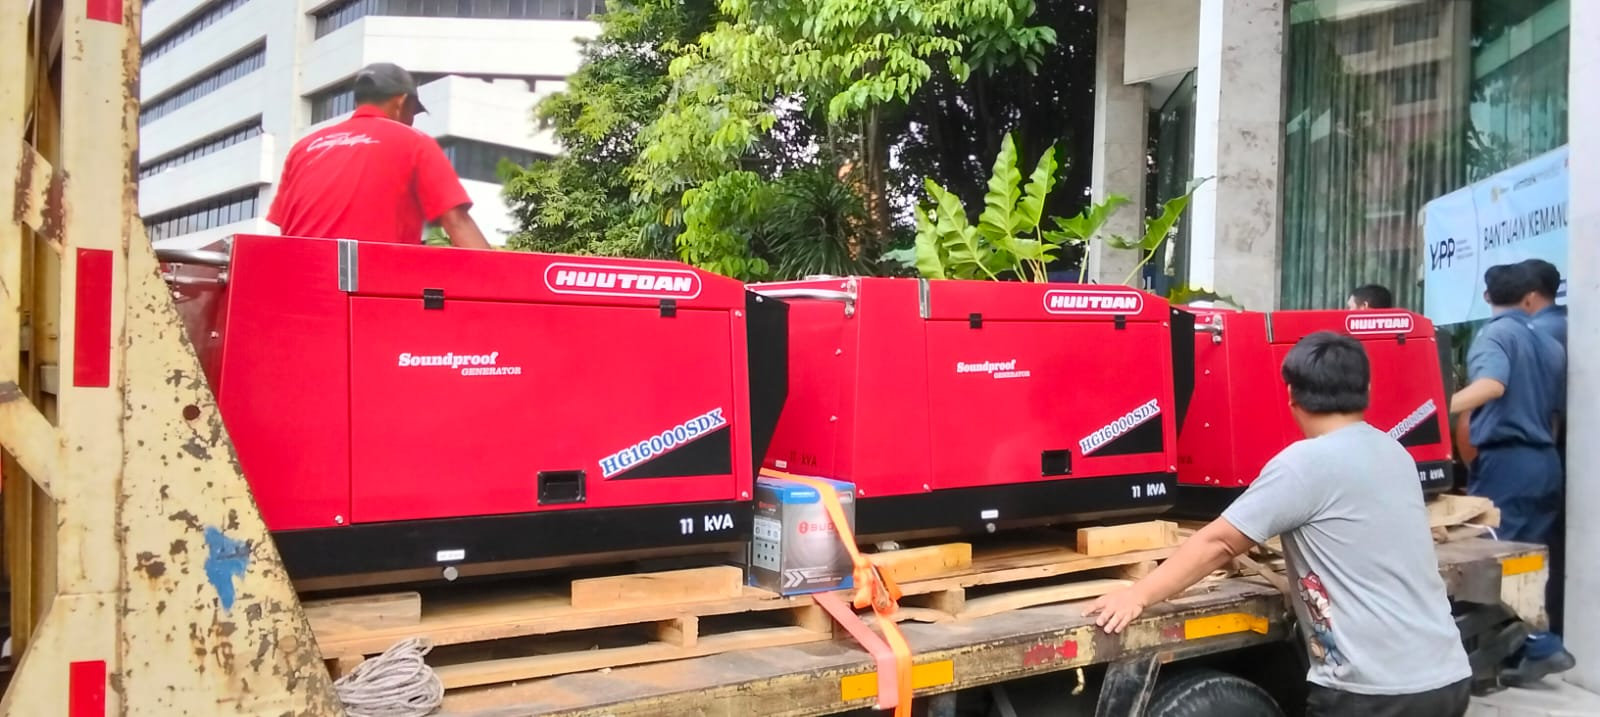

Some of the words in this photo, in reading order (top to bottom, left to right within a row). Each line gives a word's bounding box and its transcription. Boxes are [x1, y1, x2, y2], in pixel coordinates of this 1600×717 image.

[1484, 216, 1526, 251] BANTUAN
[555, 269, 692, 292] HUUTOAN
[1050, 295, 1137, 310] HUUTOAN
[398, 352, 498, 369] Soundproof
[956, 359, 1017, 374] Soundproof
[461, 366, 521, 377] GENERATOR
[1079, 398, 1160, 455] HG16000SDX
[600, 408, 726, 479] HG16000SDX
[1131, 485, 1141, 498] 11
[679, 518, 694, 534] 11
[704, 513, 734, 532] kVA
